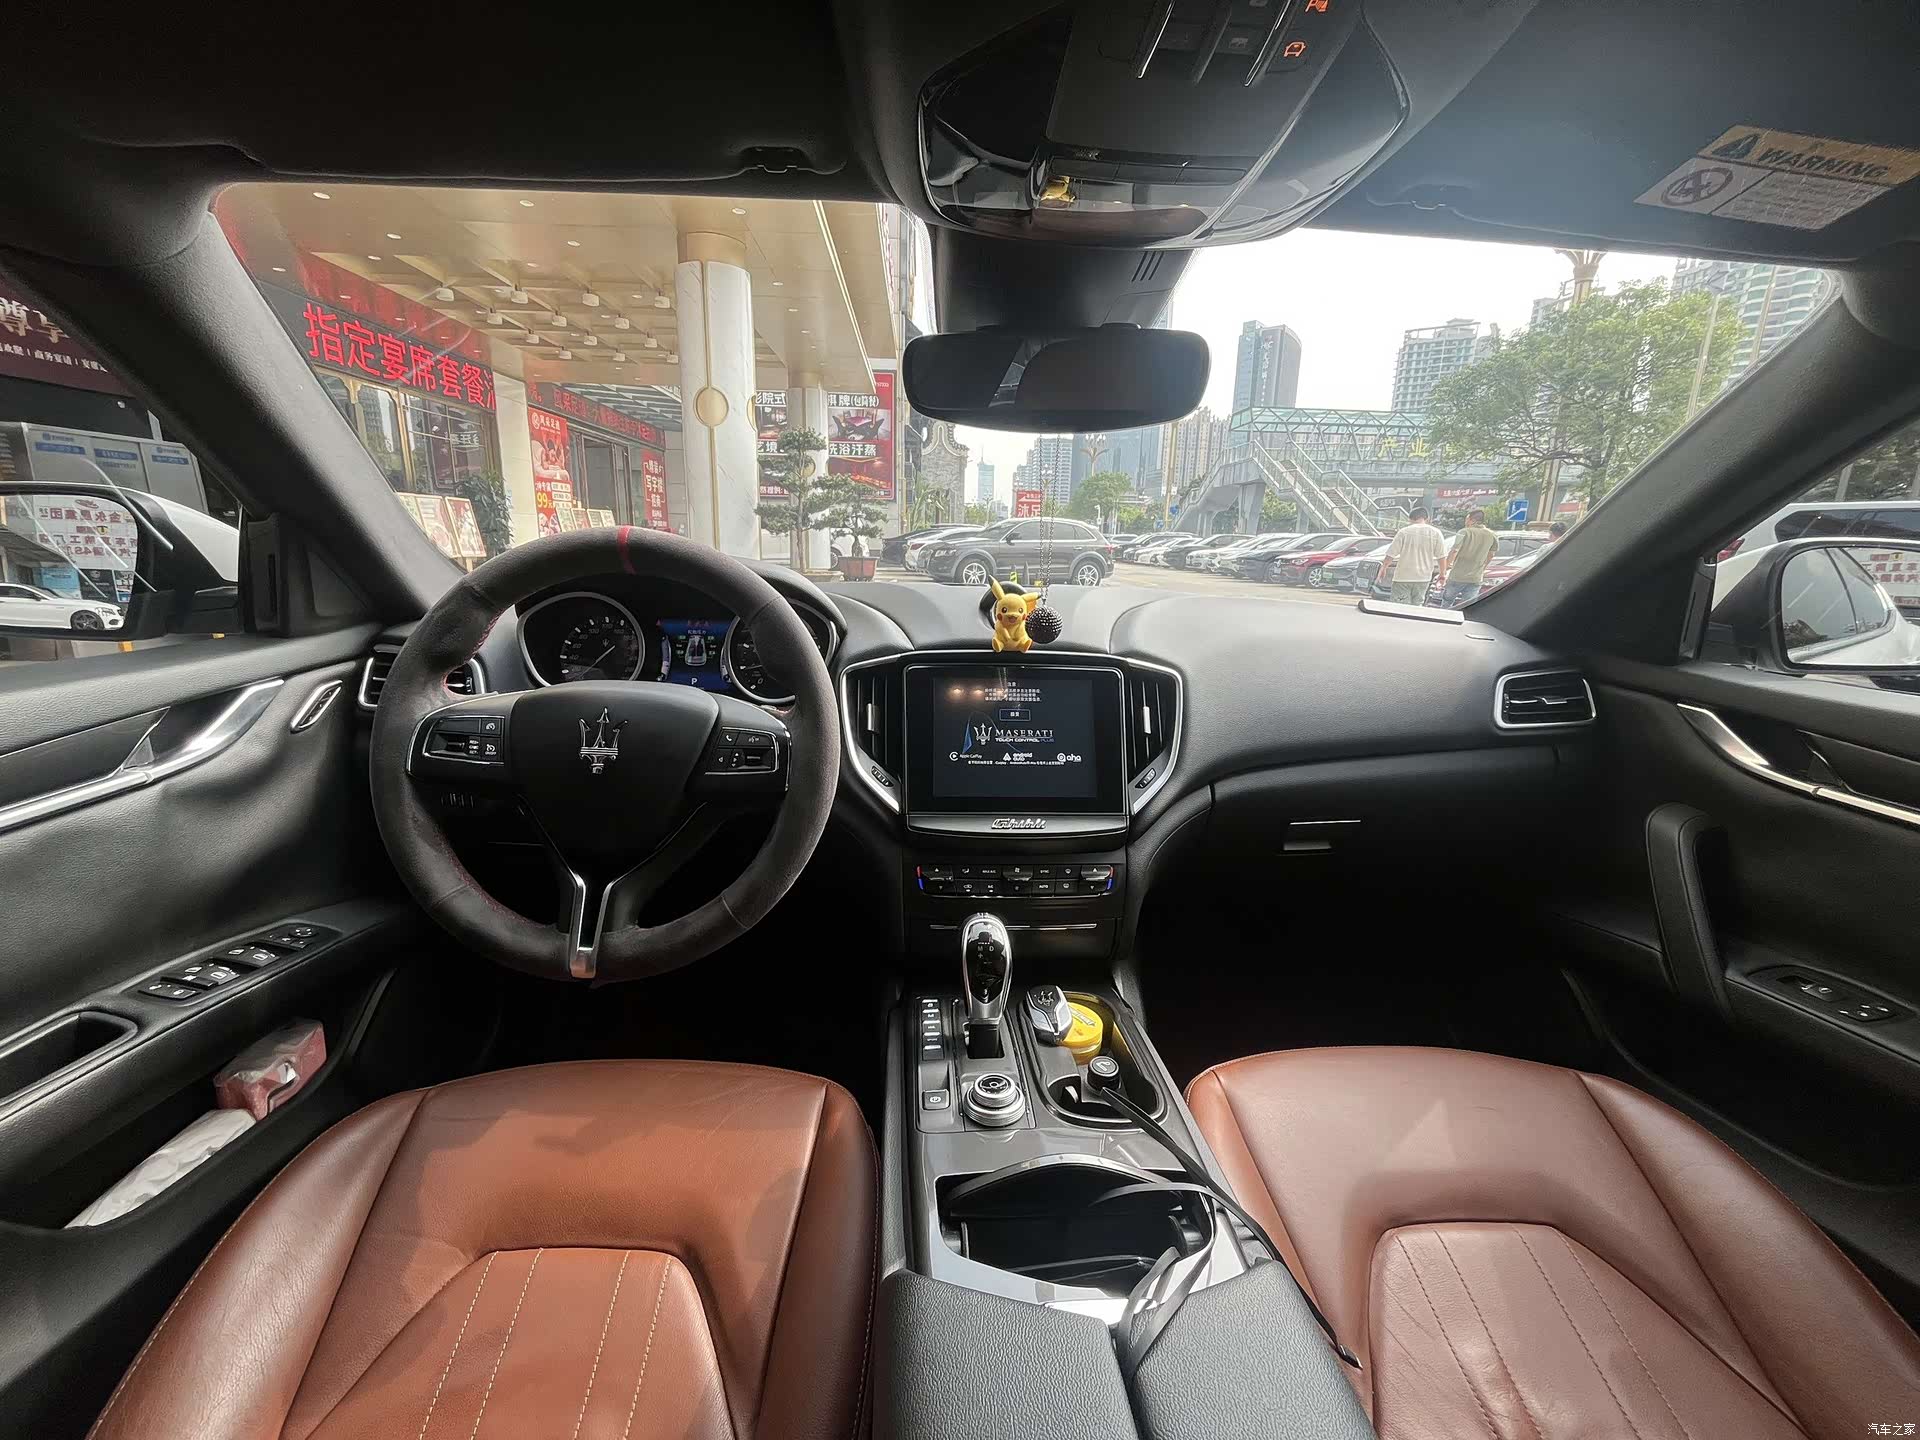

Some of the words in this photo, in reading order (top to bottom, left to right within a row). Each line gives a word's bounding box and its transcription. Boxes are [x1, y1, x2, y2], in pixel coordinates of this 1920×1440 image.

[691, 677, 698, 685] P
[995, 729, 1053, 737] MASERATI
[1066, 753, 1082, 762] aha
